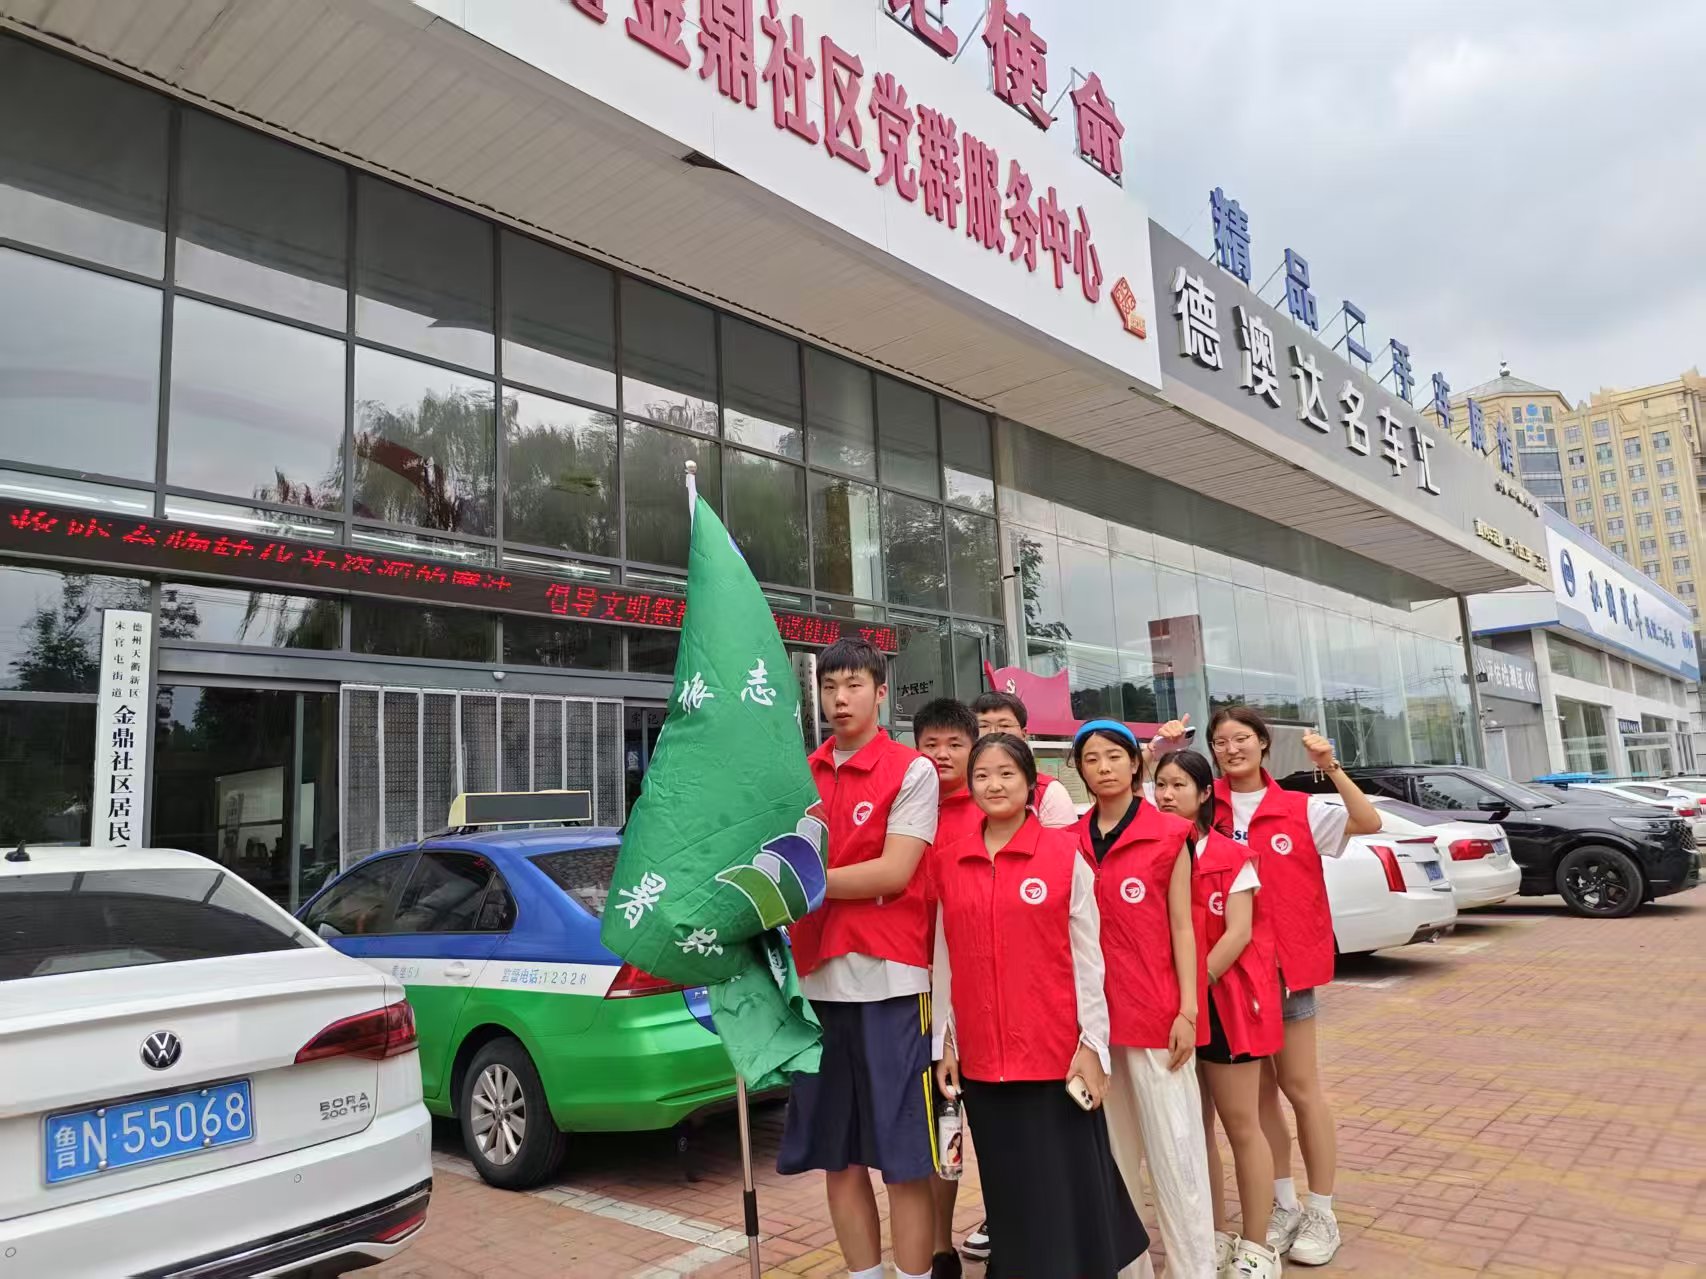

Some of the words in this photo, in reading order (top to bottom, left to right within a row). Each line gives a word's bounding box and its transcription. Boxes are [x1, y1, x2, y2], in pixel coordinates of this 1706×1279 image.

[570, 0, 1103, 303] 鼎社区党群服务中心
[1172, 266, 1441, 495] 德澳达名车汇
[112, 620, 126, 698] 宋官屯街道
[129, 621, 143, 699] 德州天衢新区
[108, 704, 136, 848] 金鼎社区居民
[319, 1092, 369, 1111] BORA
[321, 1107, 348, 1121] 200
[350, 1101, 370, 1113] TSI
